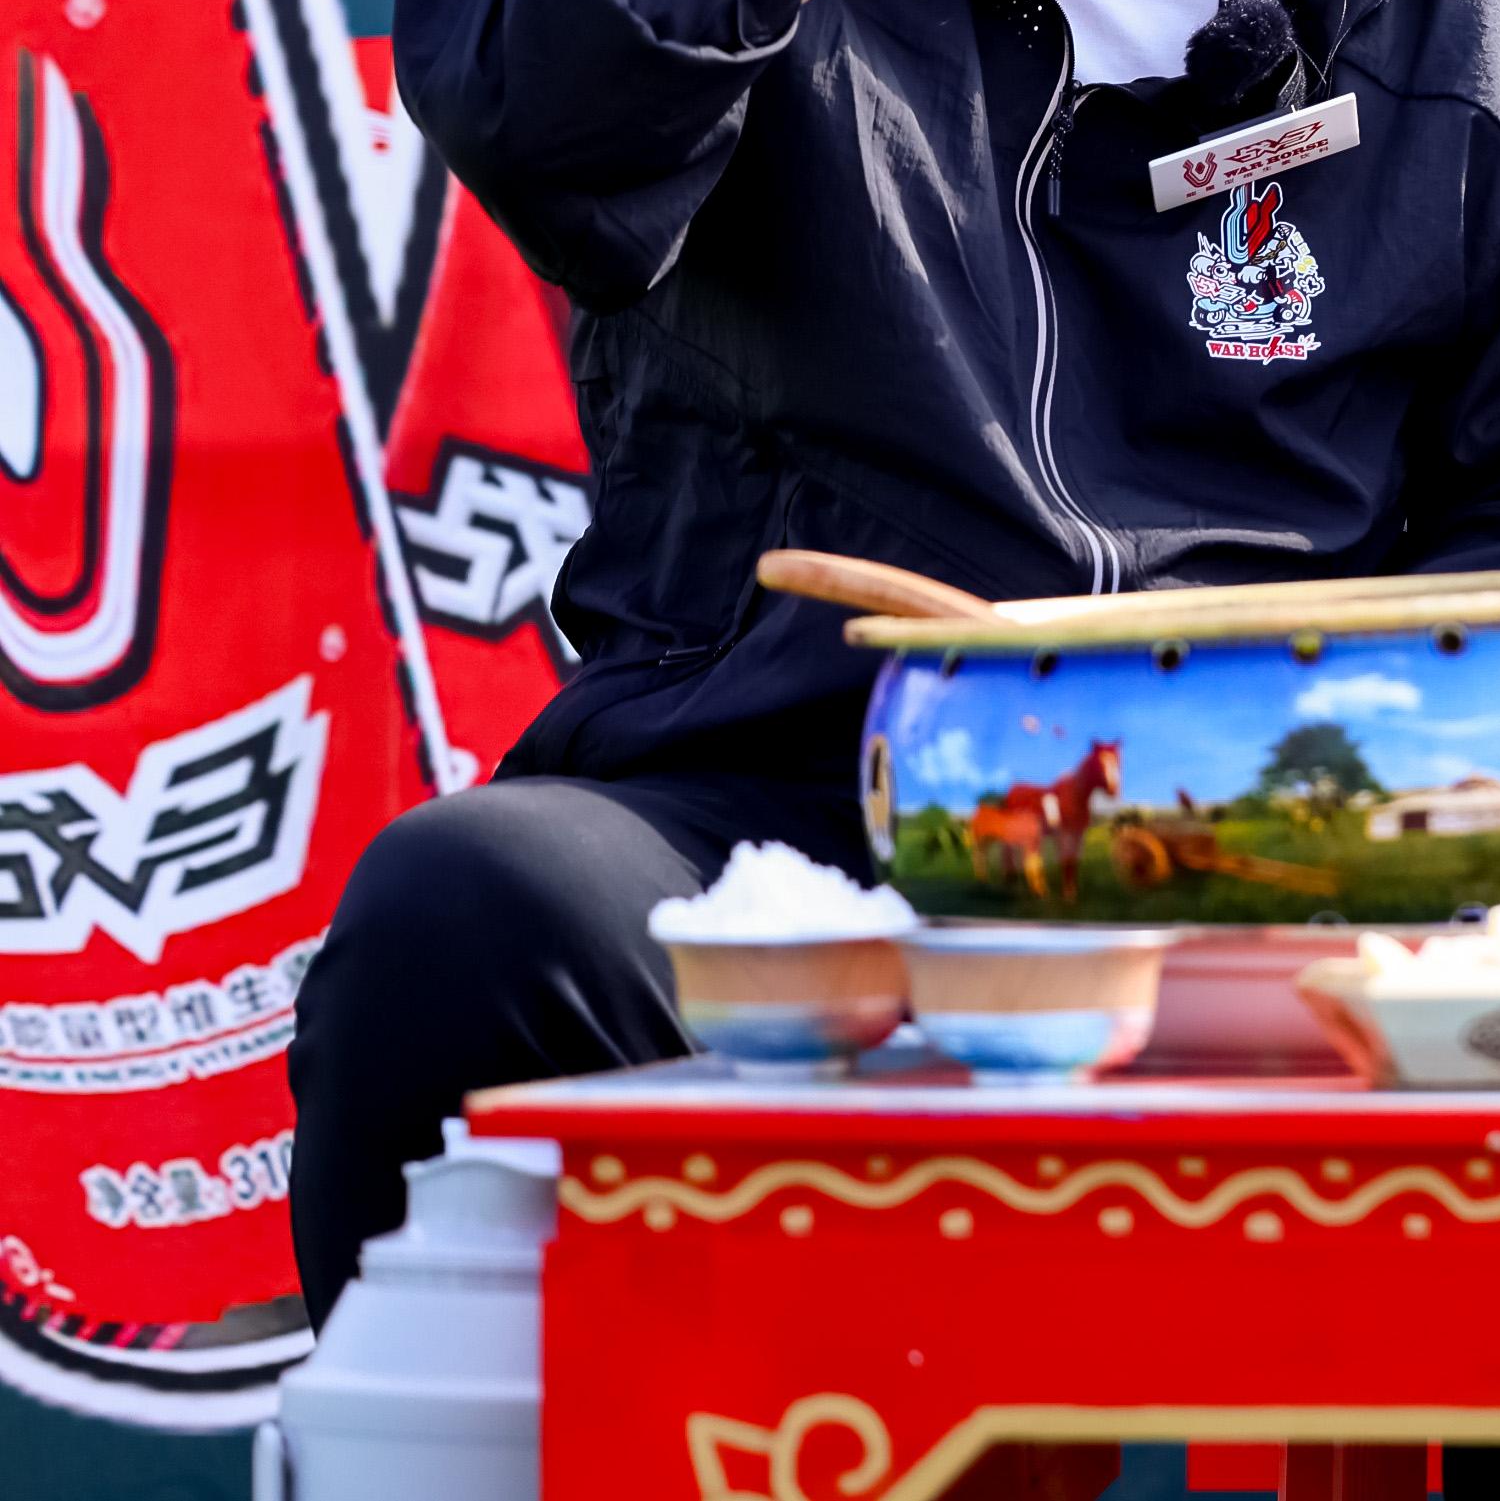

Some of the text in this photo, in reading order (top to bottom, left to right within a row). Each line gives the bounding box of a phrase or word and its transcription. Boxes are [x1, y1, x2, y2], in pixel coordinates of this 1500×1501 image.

[1223, 161, 1264, 179] WAR
[1266, 138, 1330, 166] HORSE
[1208, 341, 1306, 359] WAR HORSE
